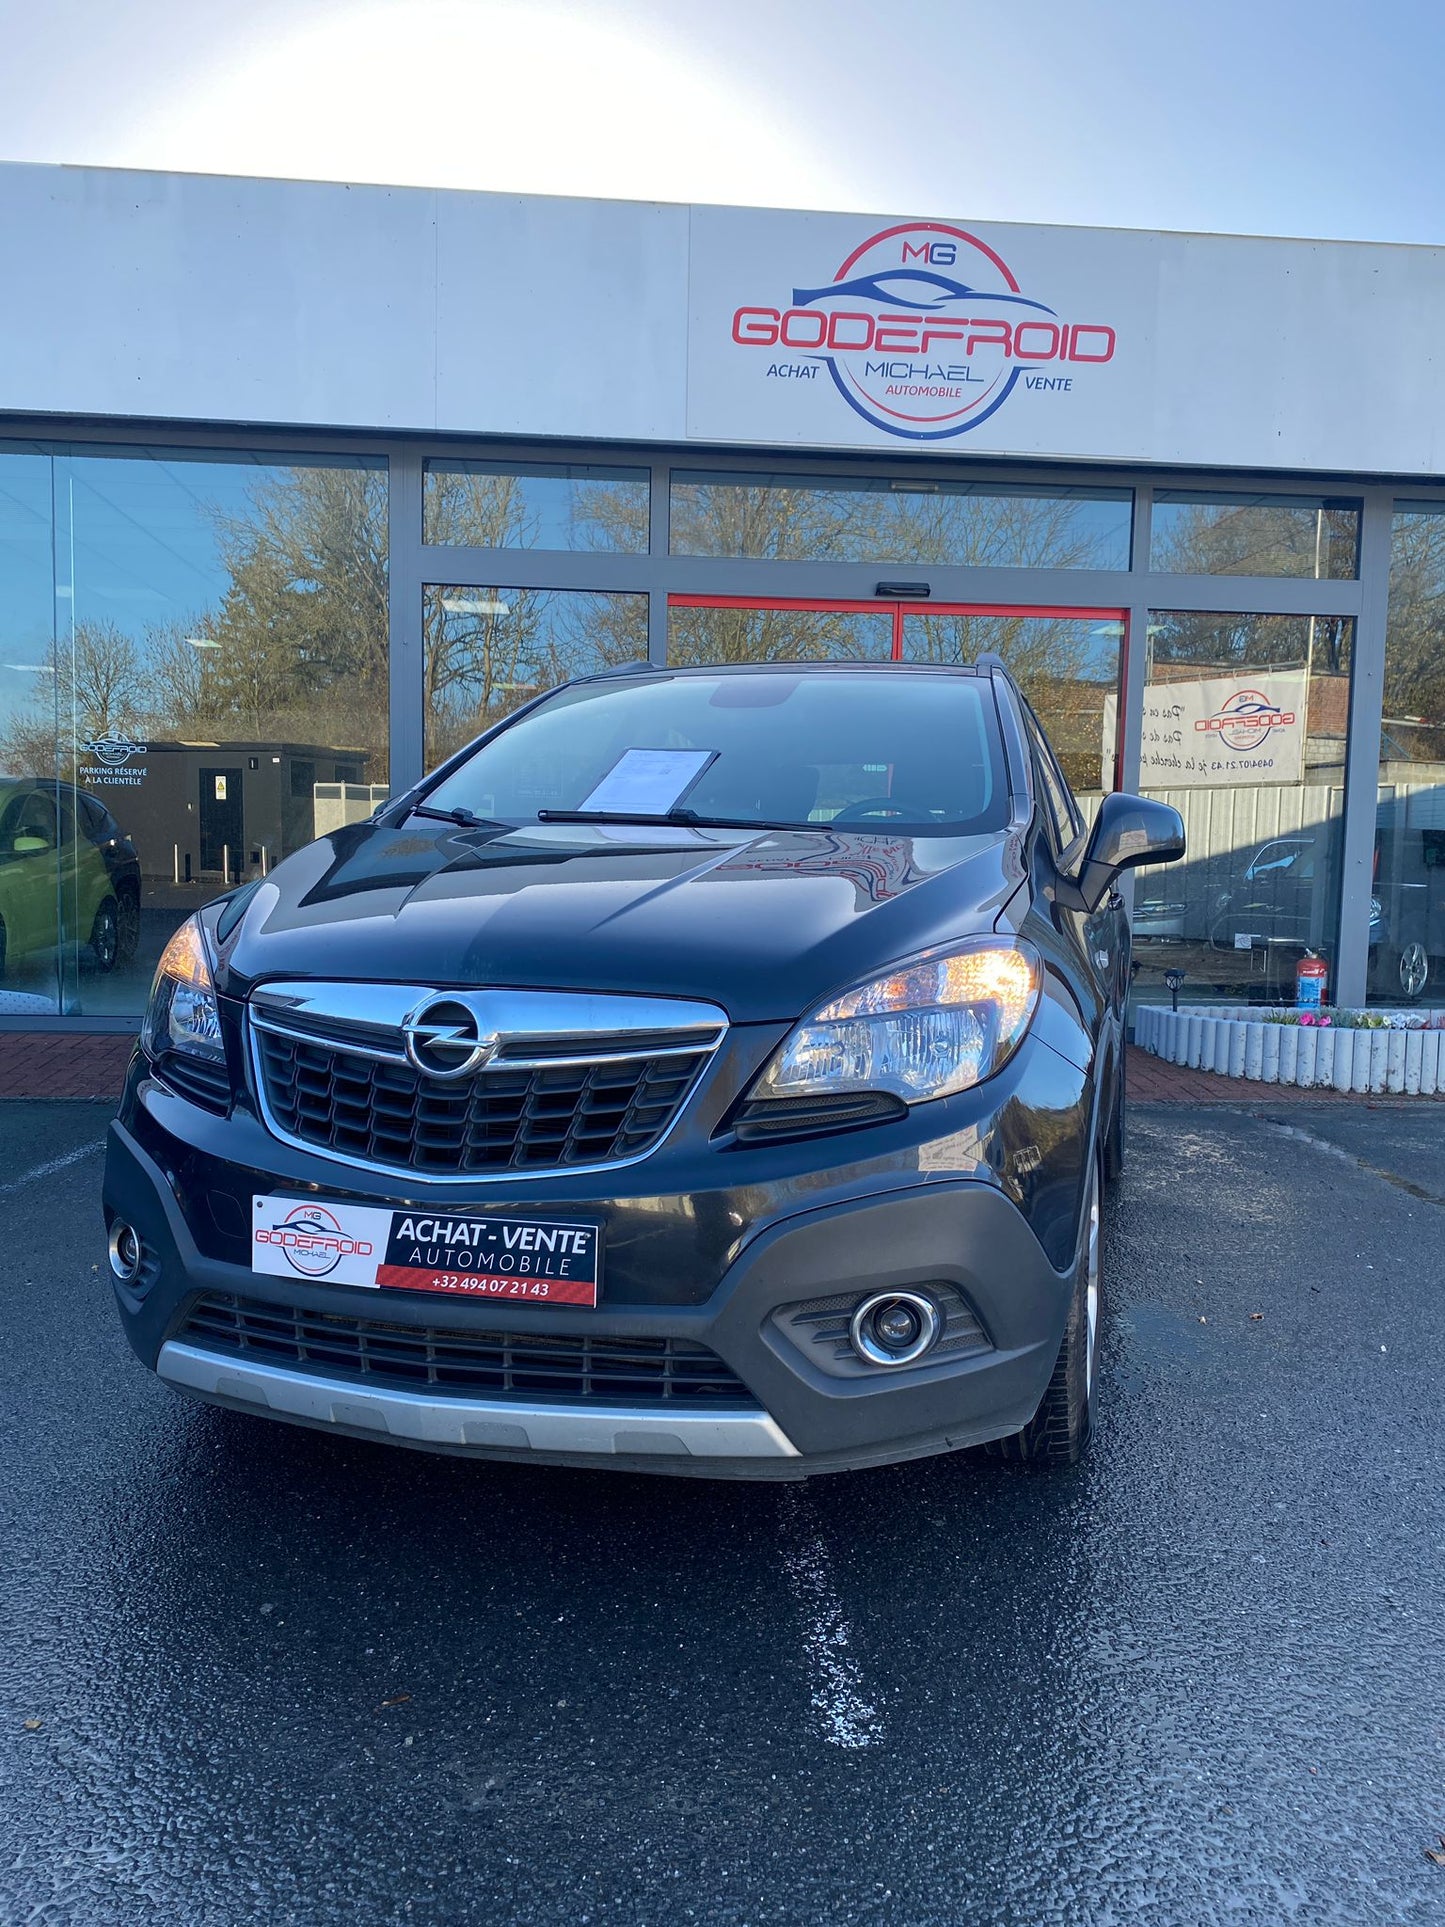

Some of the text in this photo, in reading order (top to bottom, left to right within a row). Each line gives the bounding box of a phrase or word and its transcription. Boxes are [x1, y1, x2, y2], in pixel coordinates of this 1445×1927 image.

[901, 240, 957, 266] MG
[731, 306, 1116, 363] GODEFROID
[766, 363, 820, 380] ACHAT
[864, 361, 984, 382] MICHAEL
[885, 384, 962, 399] AUTOMOBILE
[1025, 376, 1073, 392] VENTE
[79, 767, 147, 776] PARKING RÉSERVÉ
[84, 774, 142, 785] À LA CLIENTÈLE
[304, 1210, 321, 1220] MG
[255, 1229, 373, 1256] GODEFROID
[396, 1218, 486, 1246] ACHAT
[502, 1226, 588, 1255] VENTE
[293, 1248, 331, 1260] MICHAEL
[408, 1246, 572, 1276] AUTOMOBILE
[432, 1275, 549, 1296] +32 494 07 21 43
